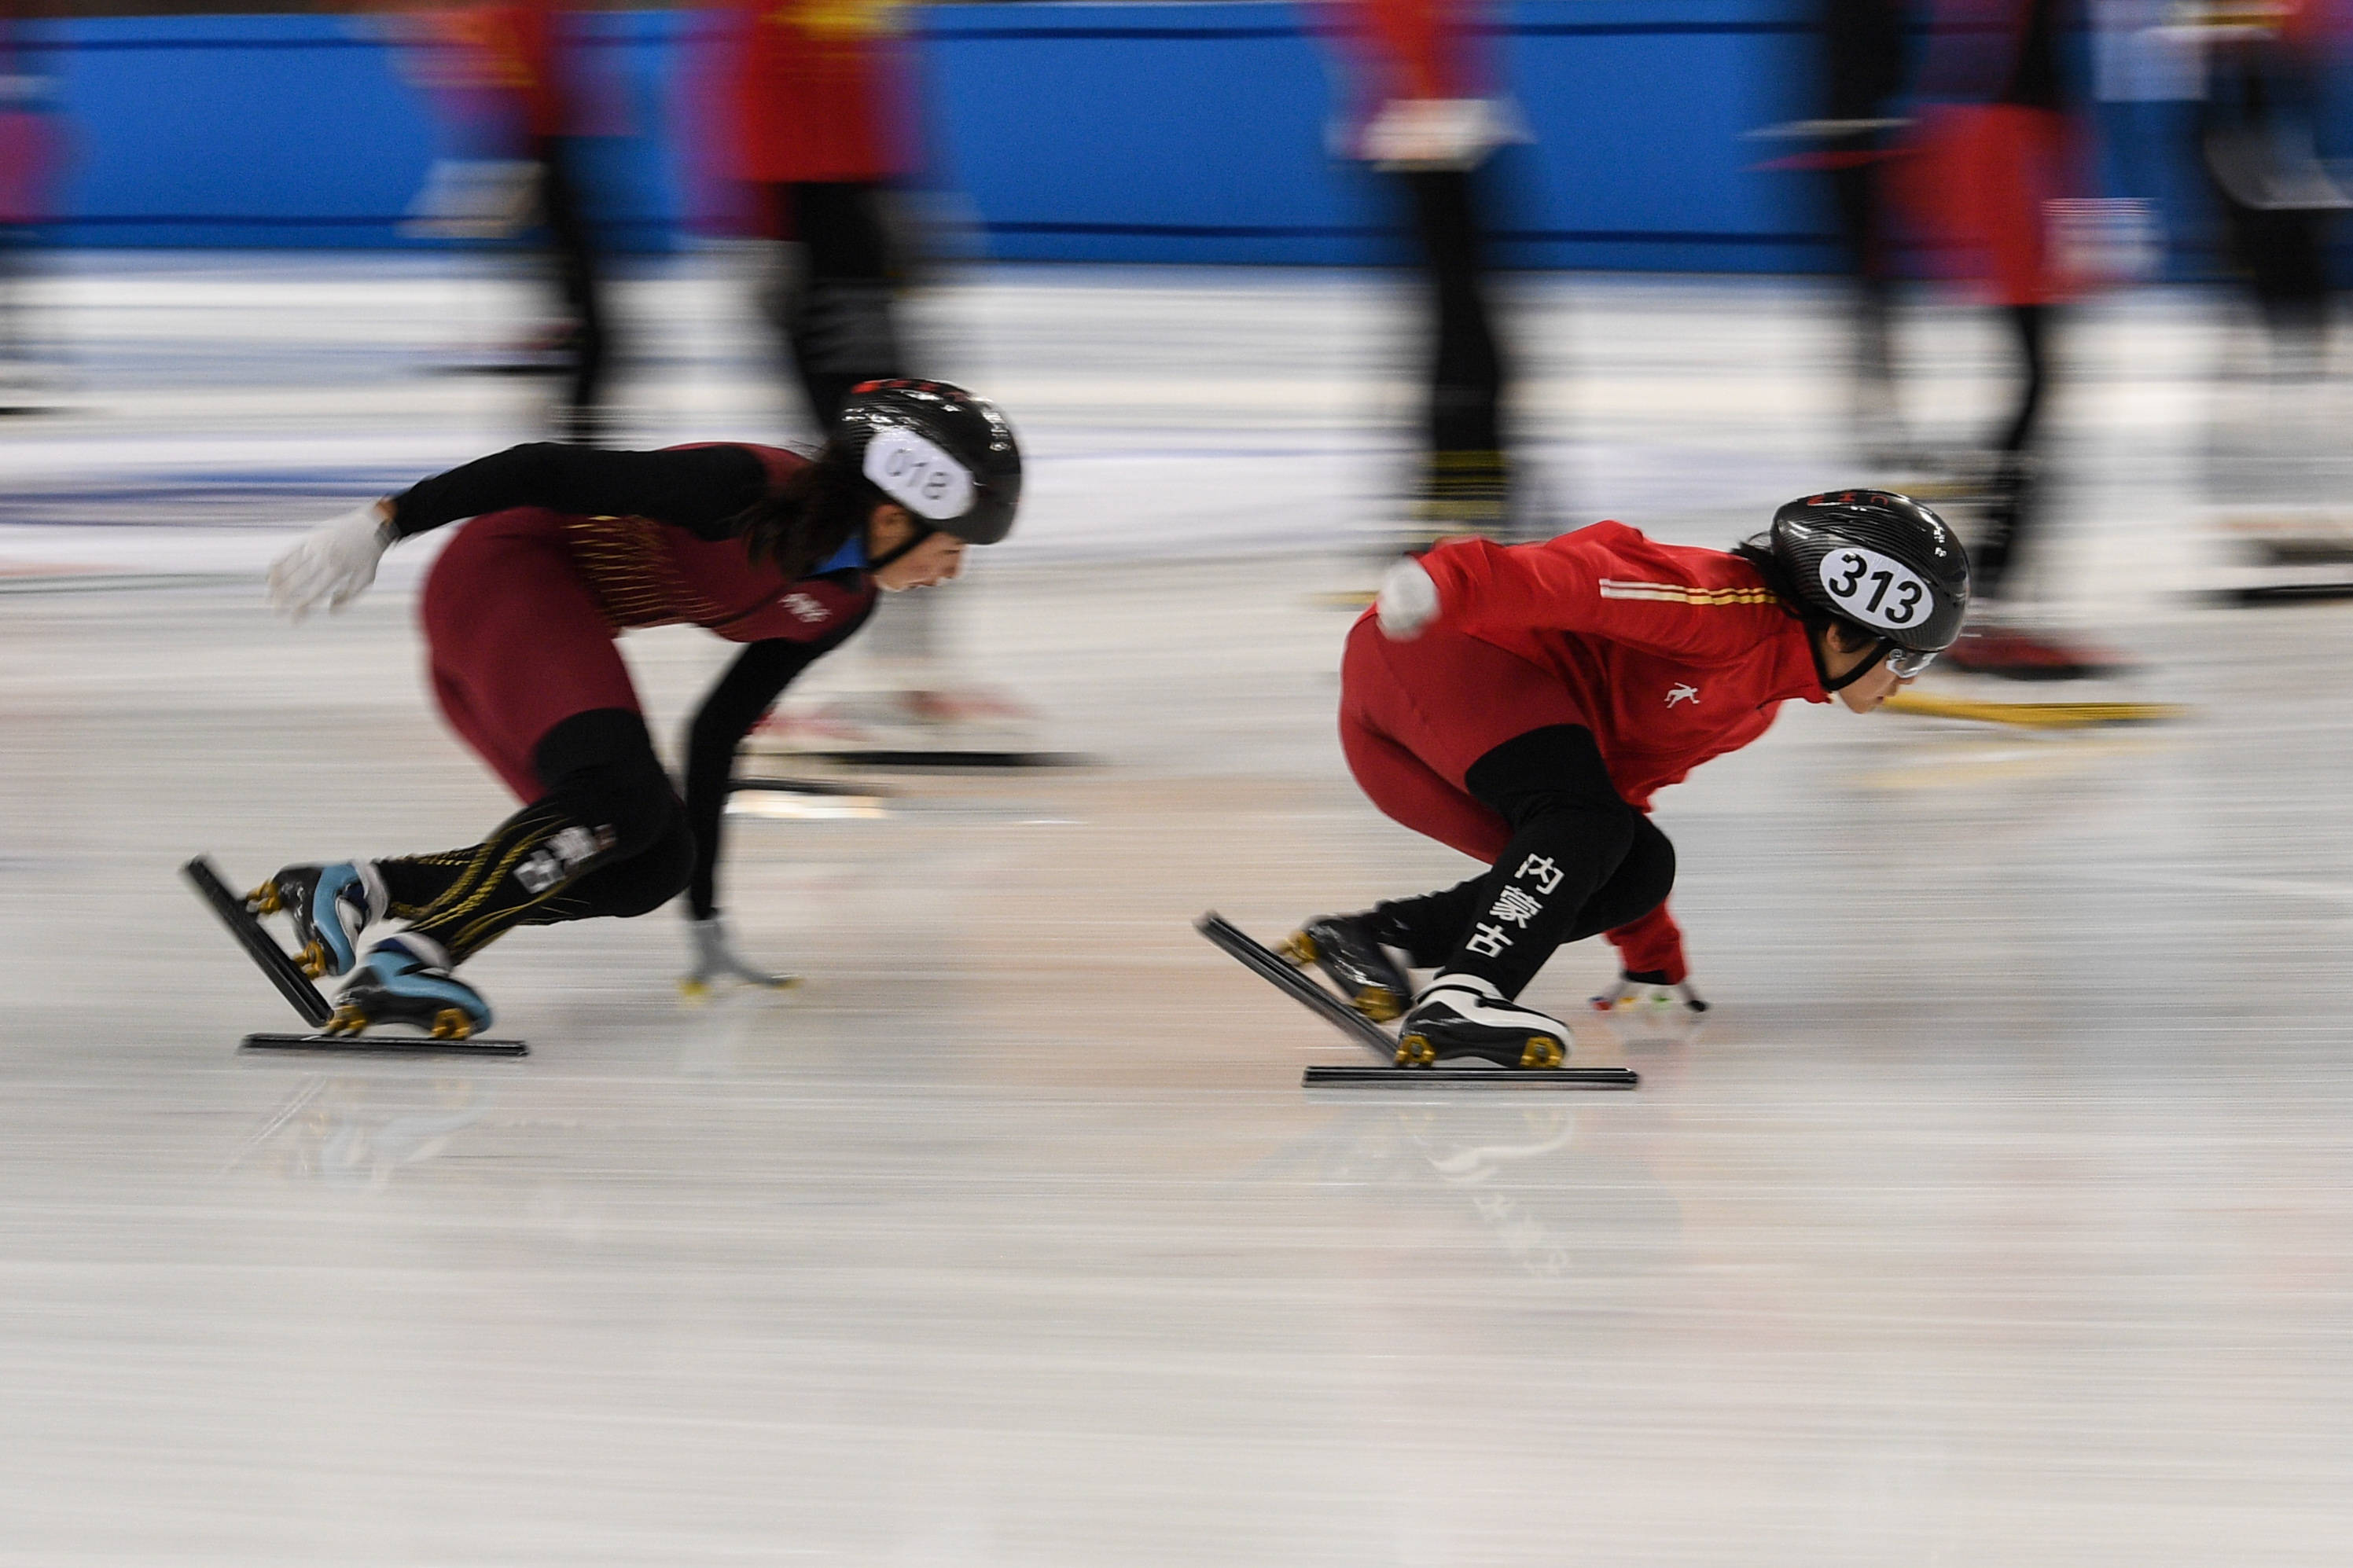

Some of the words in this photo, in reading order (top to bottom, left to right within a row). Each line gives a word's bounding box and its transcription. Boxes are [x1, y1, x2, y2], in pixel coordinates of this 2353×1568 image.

[885, 447, 951, 501] 018
[1828, 552, 1923, 624] 313
[1465, 853, 1565, 958] 内蒙古
